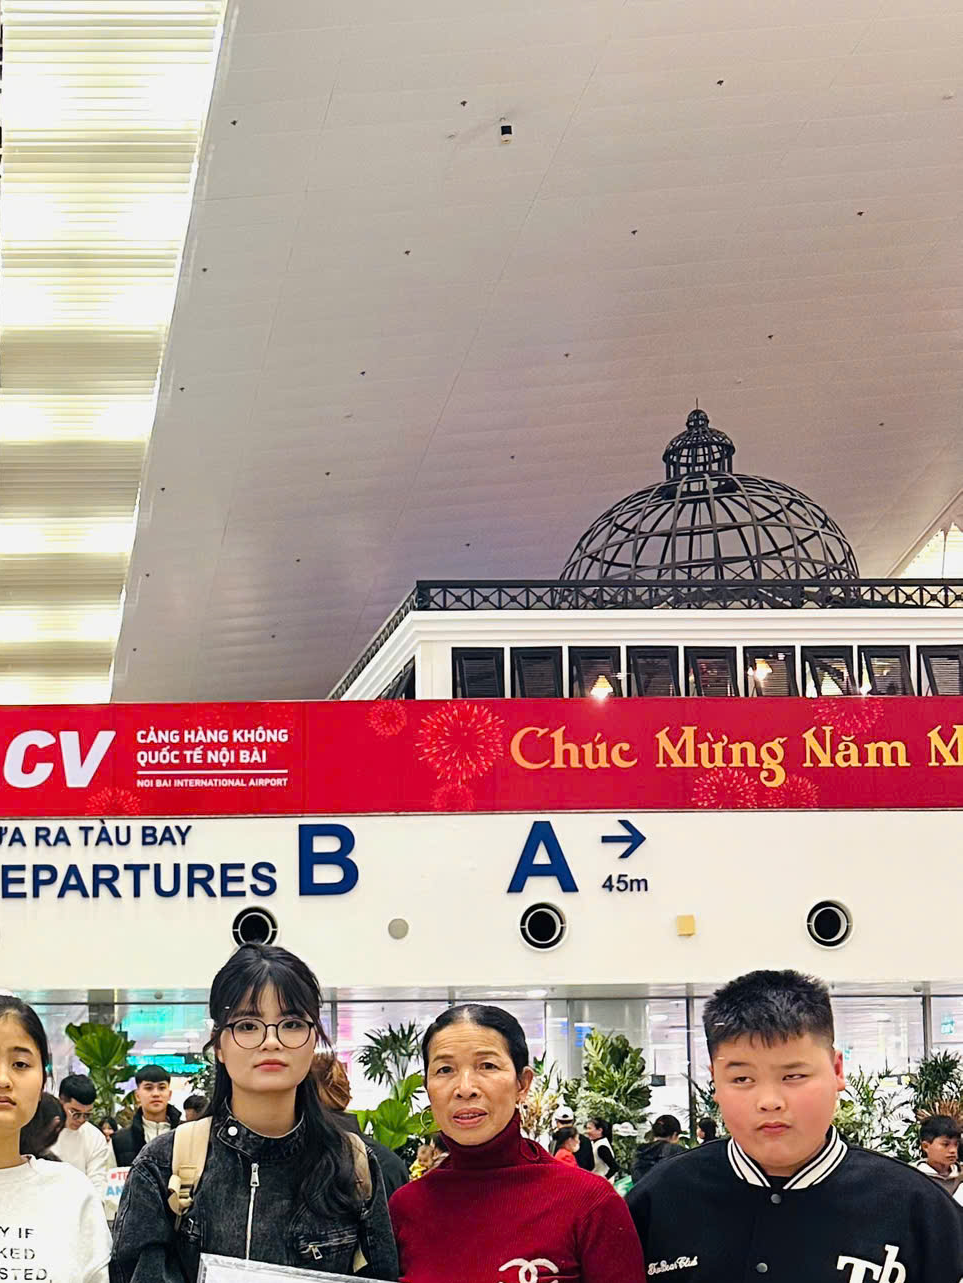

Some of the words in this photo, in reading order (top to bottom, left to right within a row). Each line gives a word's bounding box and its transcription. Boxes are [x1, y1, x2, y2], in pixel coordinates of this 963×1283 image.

[136, 726, 180, 743] CẢNG
[184, 726, 229, 743] HÀNG
[232, 726, 289, 743] KHÔNG
[137, 745, 180, 767] QUỐC
[183, 745, 204, 764] TẾ
[207, 747, 235, 767] NỘI
[239, 746, 267, 763] BÀI
[510, 726, 638, 770] Chúc
[655, 726, 786, 788] Mừng
[802, 726, 911, 769] Năm
[137, 779, 154, 788] NOI
[155, 779, 172, 788] BAI
[174, 778, 246, 788] INTERNATIONAL
[249, 777, 288, 787] AIRPORT
[35, 826, 71, 847] RA
[77, 819, 132, 846] TÀU
[141, 825, 193, 846] BAY
[298, 824, 359, 896] B
[507, 820, 579, 893] A
[601, 874, 649, 892] 45m
[18, 1227, 35, 1238] IF
